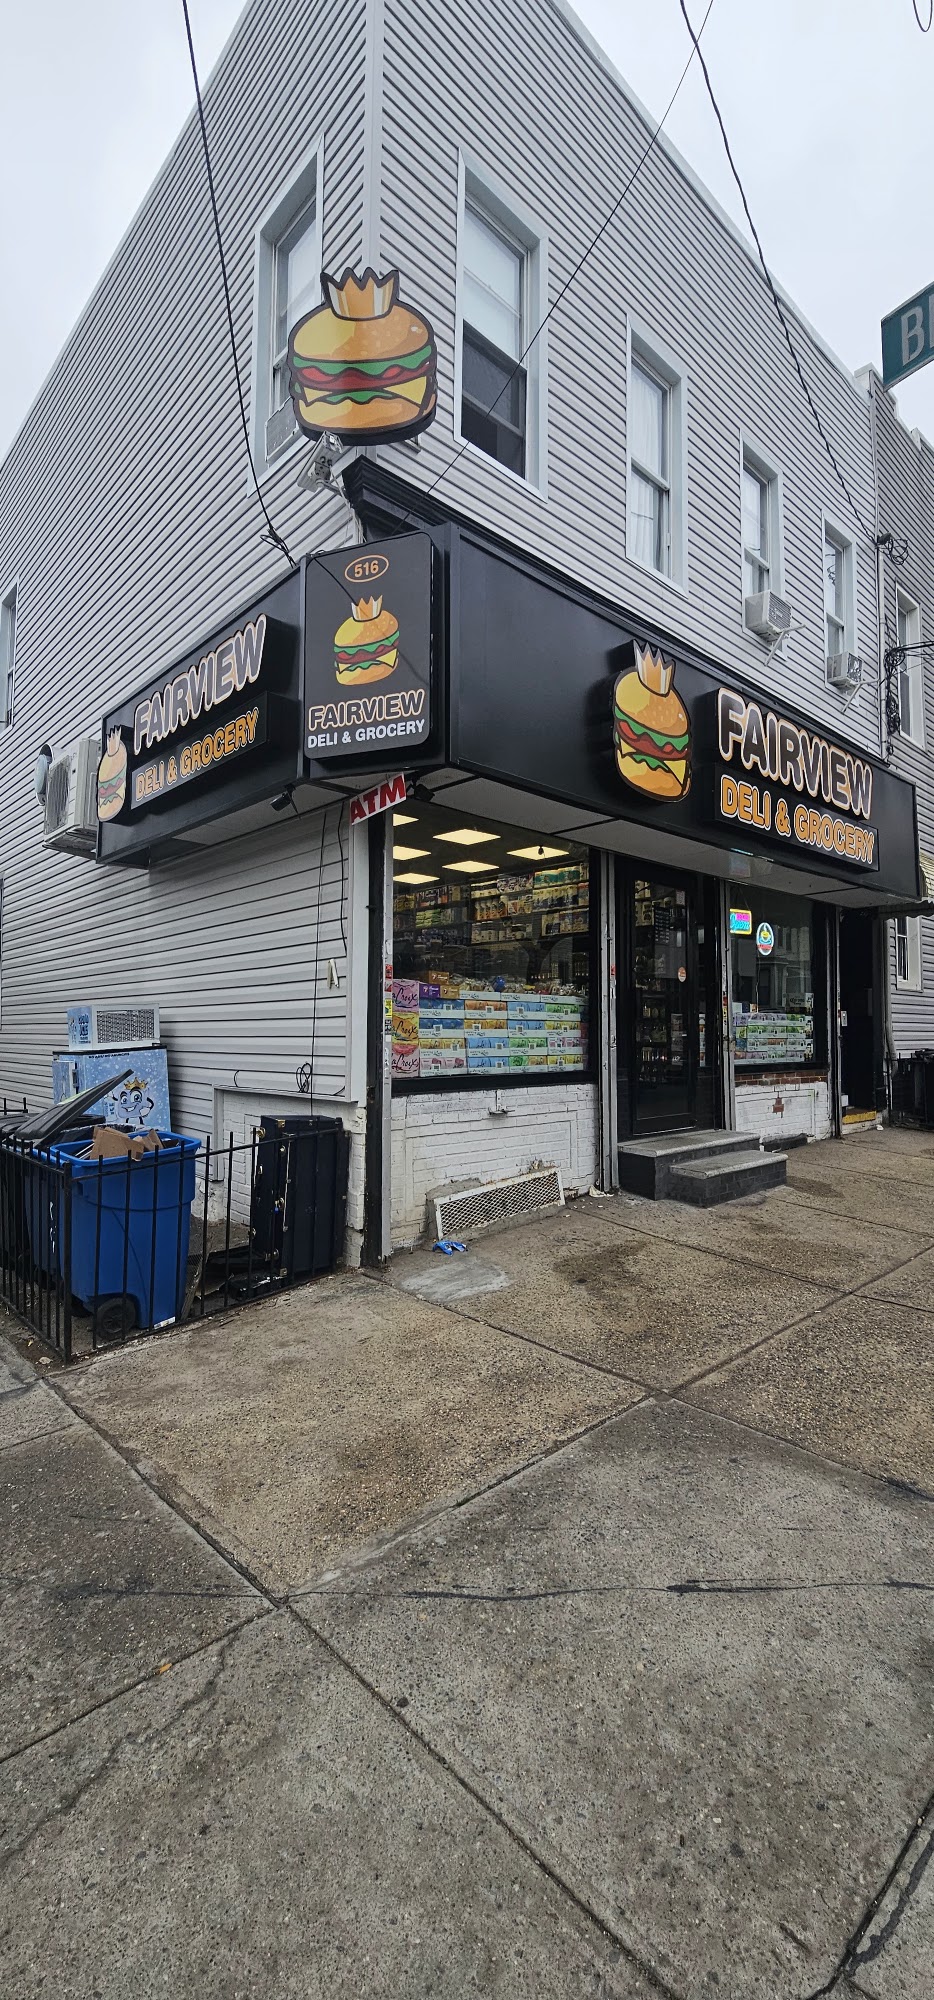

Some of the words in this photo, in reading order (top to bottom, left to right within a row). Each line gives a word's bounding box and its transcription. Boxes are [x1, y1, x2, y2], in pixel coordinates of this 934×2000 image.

[354, 559, 380, 578] 516
[134, 613, 267, 755] FAIRVIEW
[308, 689, 425, 731] FAIRVIEW
[136, 761, 164, 801] DELI
[166, 756, 178, 785] &
[180, 707, 259, 778] GROCERY
[308, 732, 338, 748] DELI
[342, 731, 351, 744] &
[355, 719, 425, 742] GROCERY
[718, 687, 873, 820] FAIRVIEW
[350, 774, 406, 825] ATM
[720, 774, 771, 831] DELI
[775, 798, 791, 837] &
[794, 804, 874, 864] GROCERY
